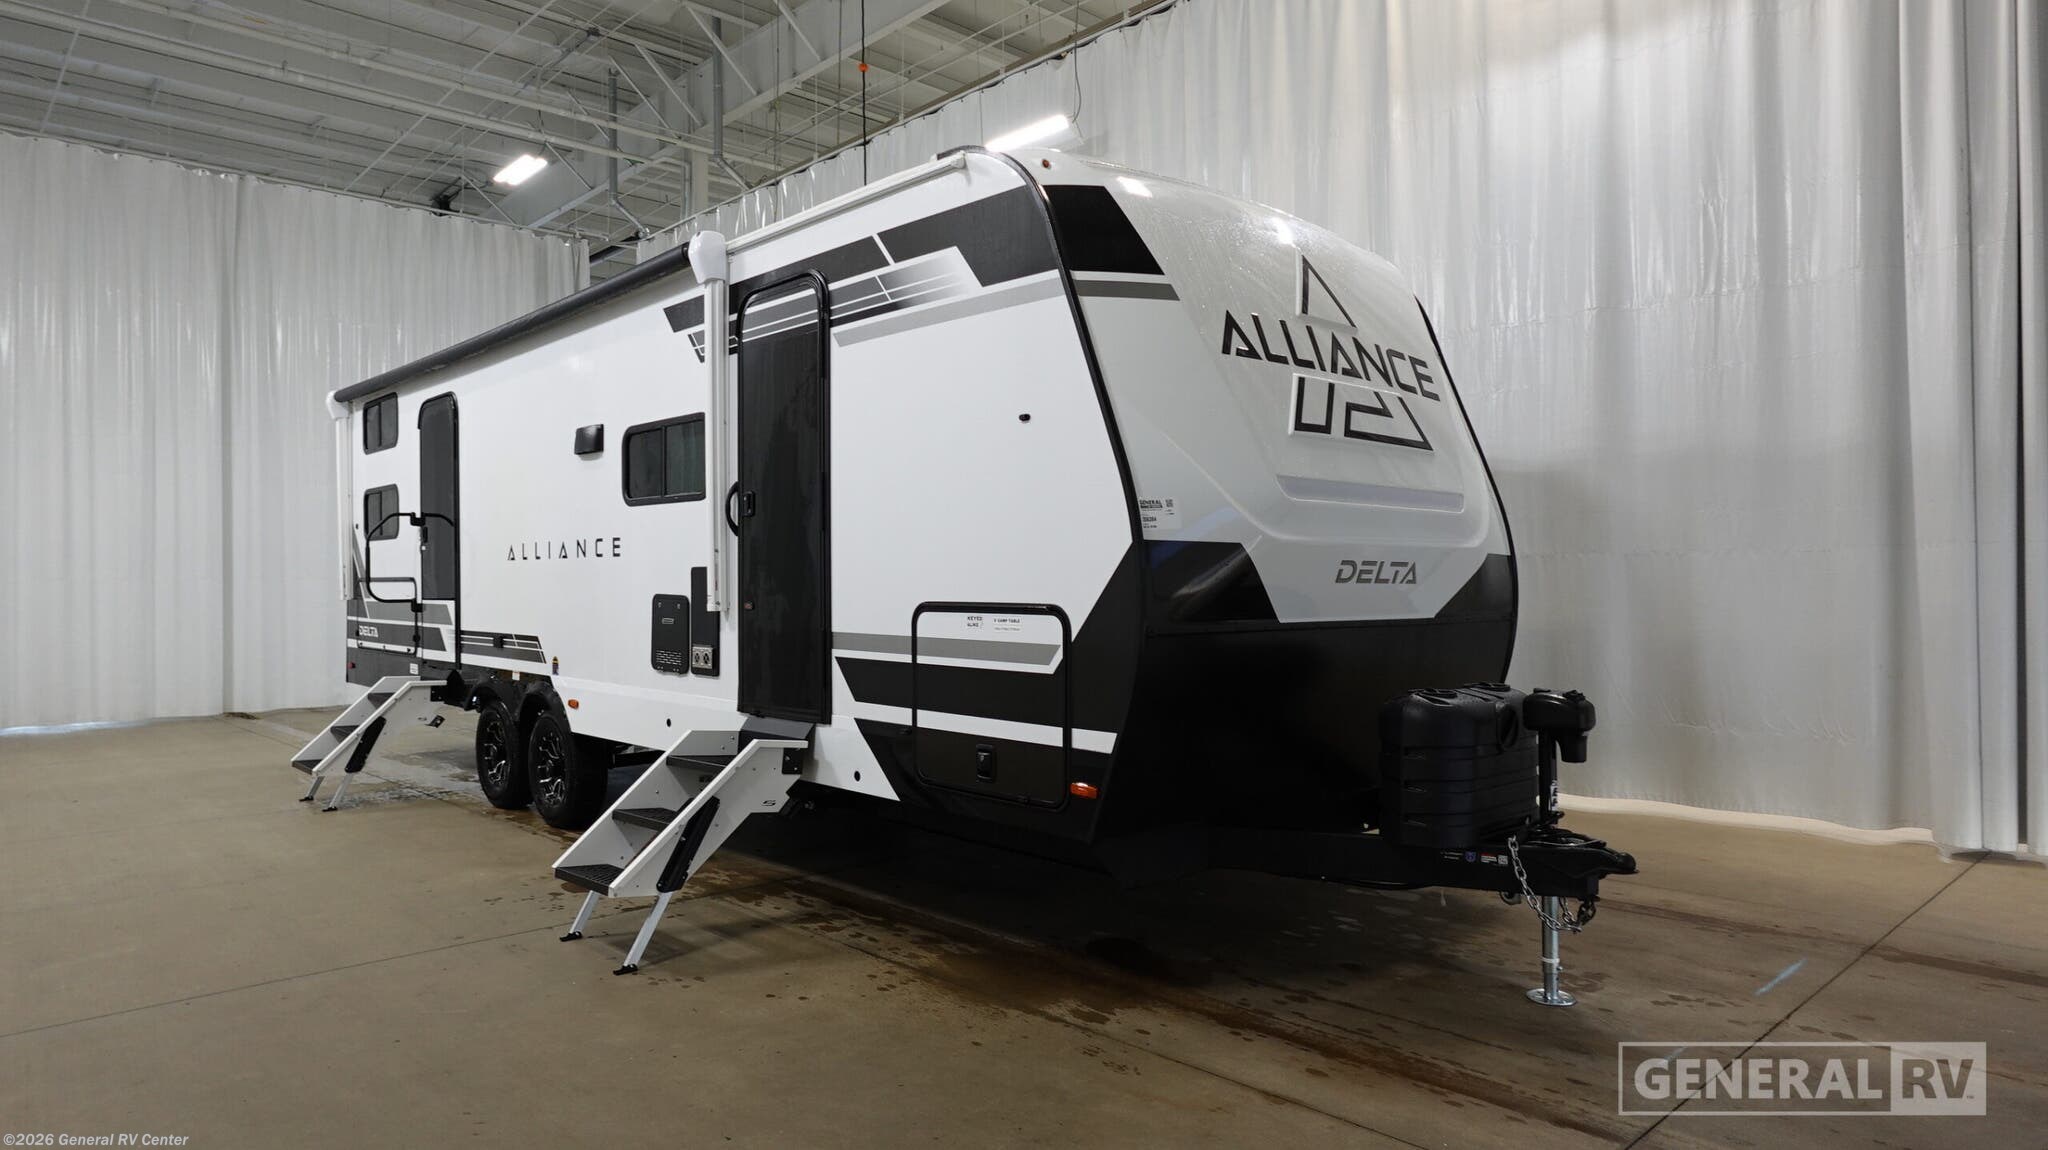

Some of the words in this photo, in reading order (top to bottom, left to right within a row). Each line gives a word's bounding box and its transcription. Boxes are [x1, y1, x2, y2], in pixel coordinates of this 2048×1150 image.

[1221, 310, 1440, 401] ALLIANCE
[507, 537, 622, 561] ALLIANCE
[1335, 560, 1417, 584] DELTA
[358, 625, 379, 638] DELTA
